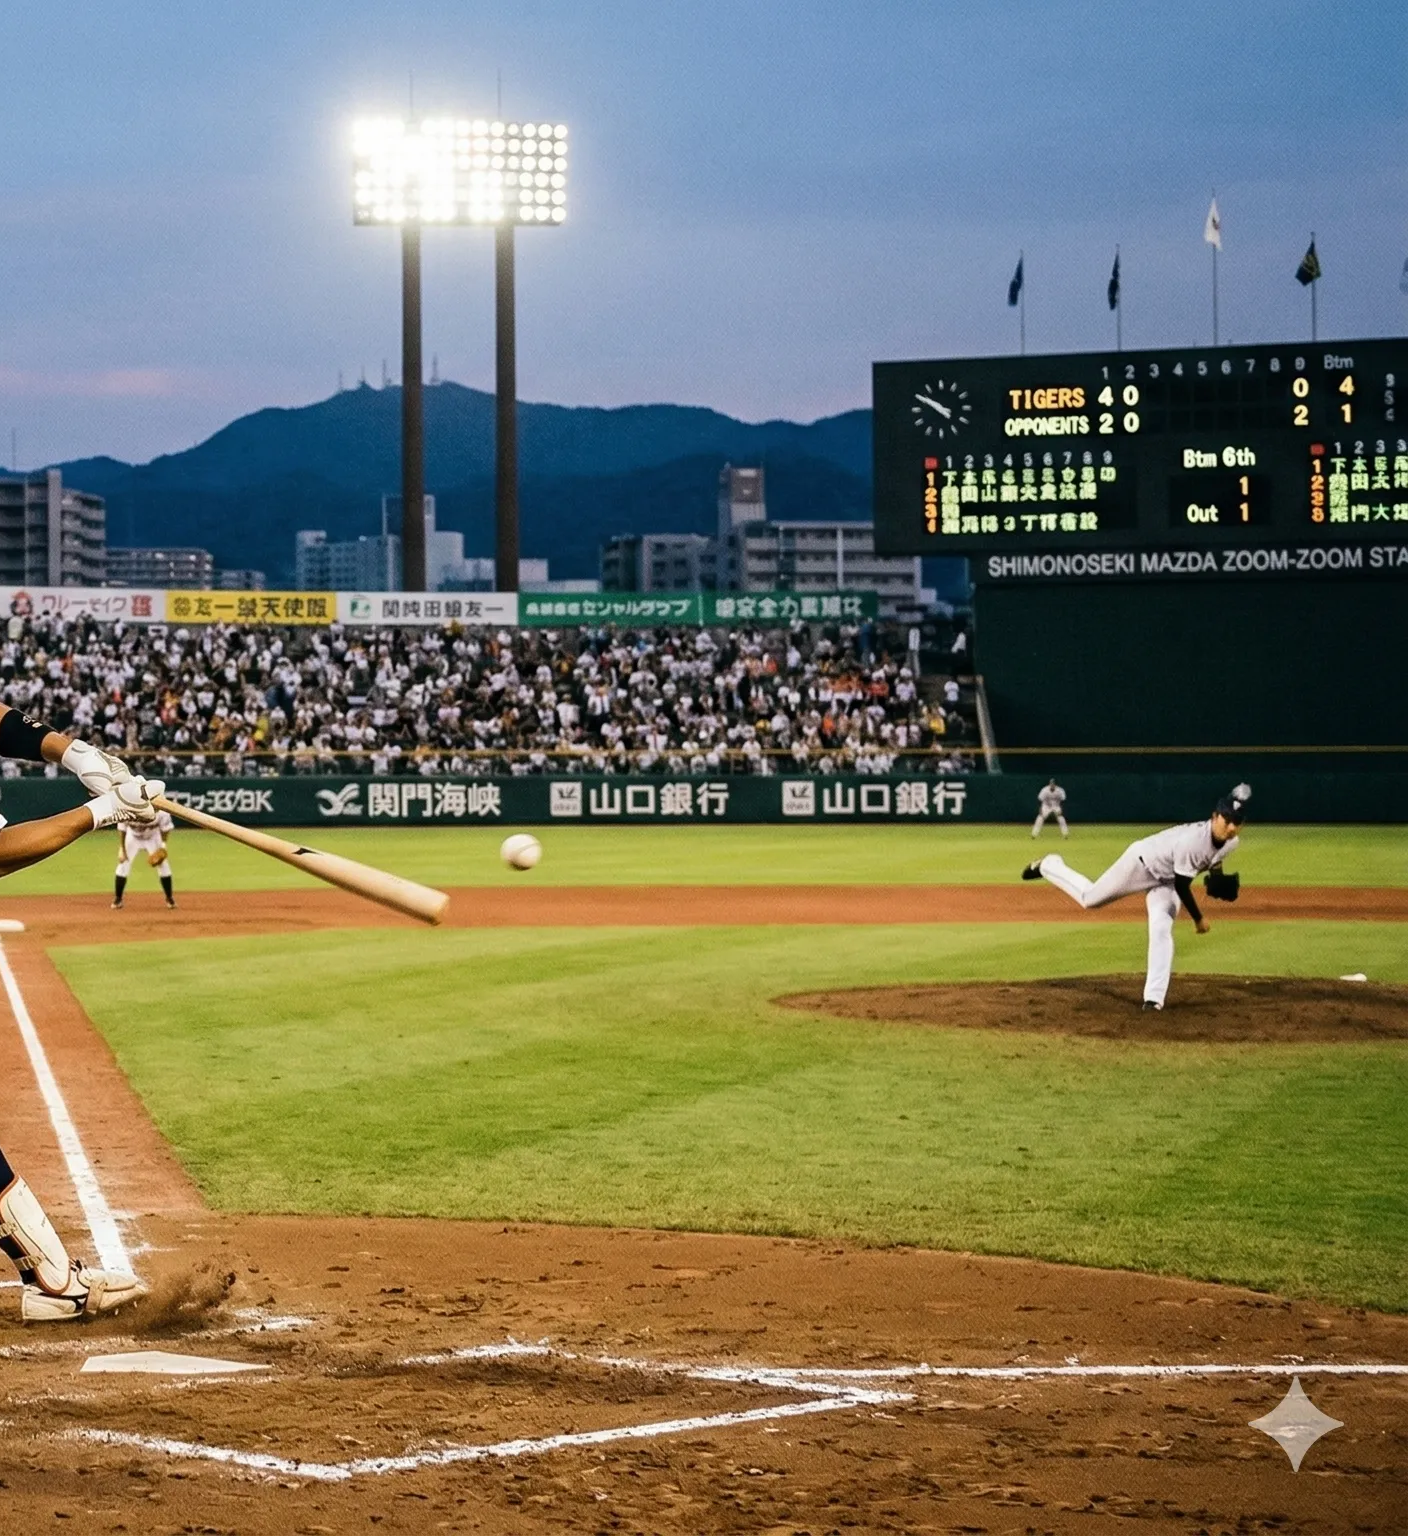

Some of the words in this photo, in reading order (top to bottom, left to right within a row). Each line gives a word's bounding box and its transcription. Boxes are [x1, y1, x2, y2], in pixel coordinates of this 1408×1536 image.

[1101, 366, 1109, 380] 1
[1125, 364, 1135, 379] 2
[1149, 363, 1159, 378] 3
[1173, 362, 1183, 377] 4
[1197, 361, 1208, 375] 5
[1221, 360, 1232, 374] 6
[1246, 359, 1255, 373] 7
[1270, 357, 1280, 372] 8
[1324, 354, 1354, 370] Btm
[1009, 387, 1085, 410] TIGERS
[1098, 386, 1113, 407] 4
[1123, 385, 1139, 406] 0
[1293, 377, 1309, 398] 0
[1339, 375, 1355, 396] 4
[1005, 415, 1090, 437] OPPONENTS
[1099, 413, 1114, 434] 2
[1123, 411, 1140, 433] 0
[1293, 405, 1309, 426] 2
[1341, 403, 1352, 424] 1
[1183, 448, 1218, 468] Btm
[1222, 446, 1256, 467] 6th
[1354, 440, 1364, 455] 2
[1376, 439, 1385, 454] 3
[1311, 458, 1322, 474] 1
[924, 487, 937, 502] 2
[1239, 476, 1250, 496] 1
[1311, 475, 1324, 490] 2
[1187, 503, 1219, 523] Out
[1239, 502, 1250, 522] 1
[988, 554, 1135, 577] SHIMONOSEKI
[1141, 551, 1218, 574] MAZDA
[1222, 547, 1363, 572] ZOOM-ZOOM
[368, 782, 501, 817] 関門海峡
[589, 782, 729, 815] 山口銀行
[823, 781, 966, 815] 山口銀行
